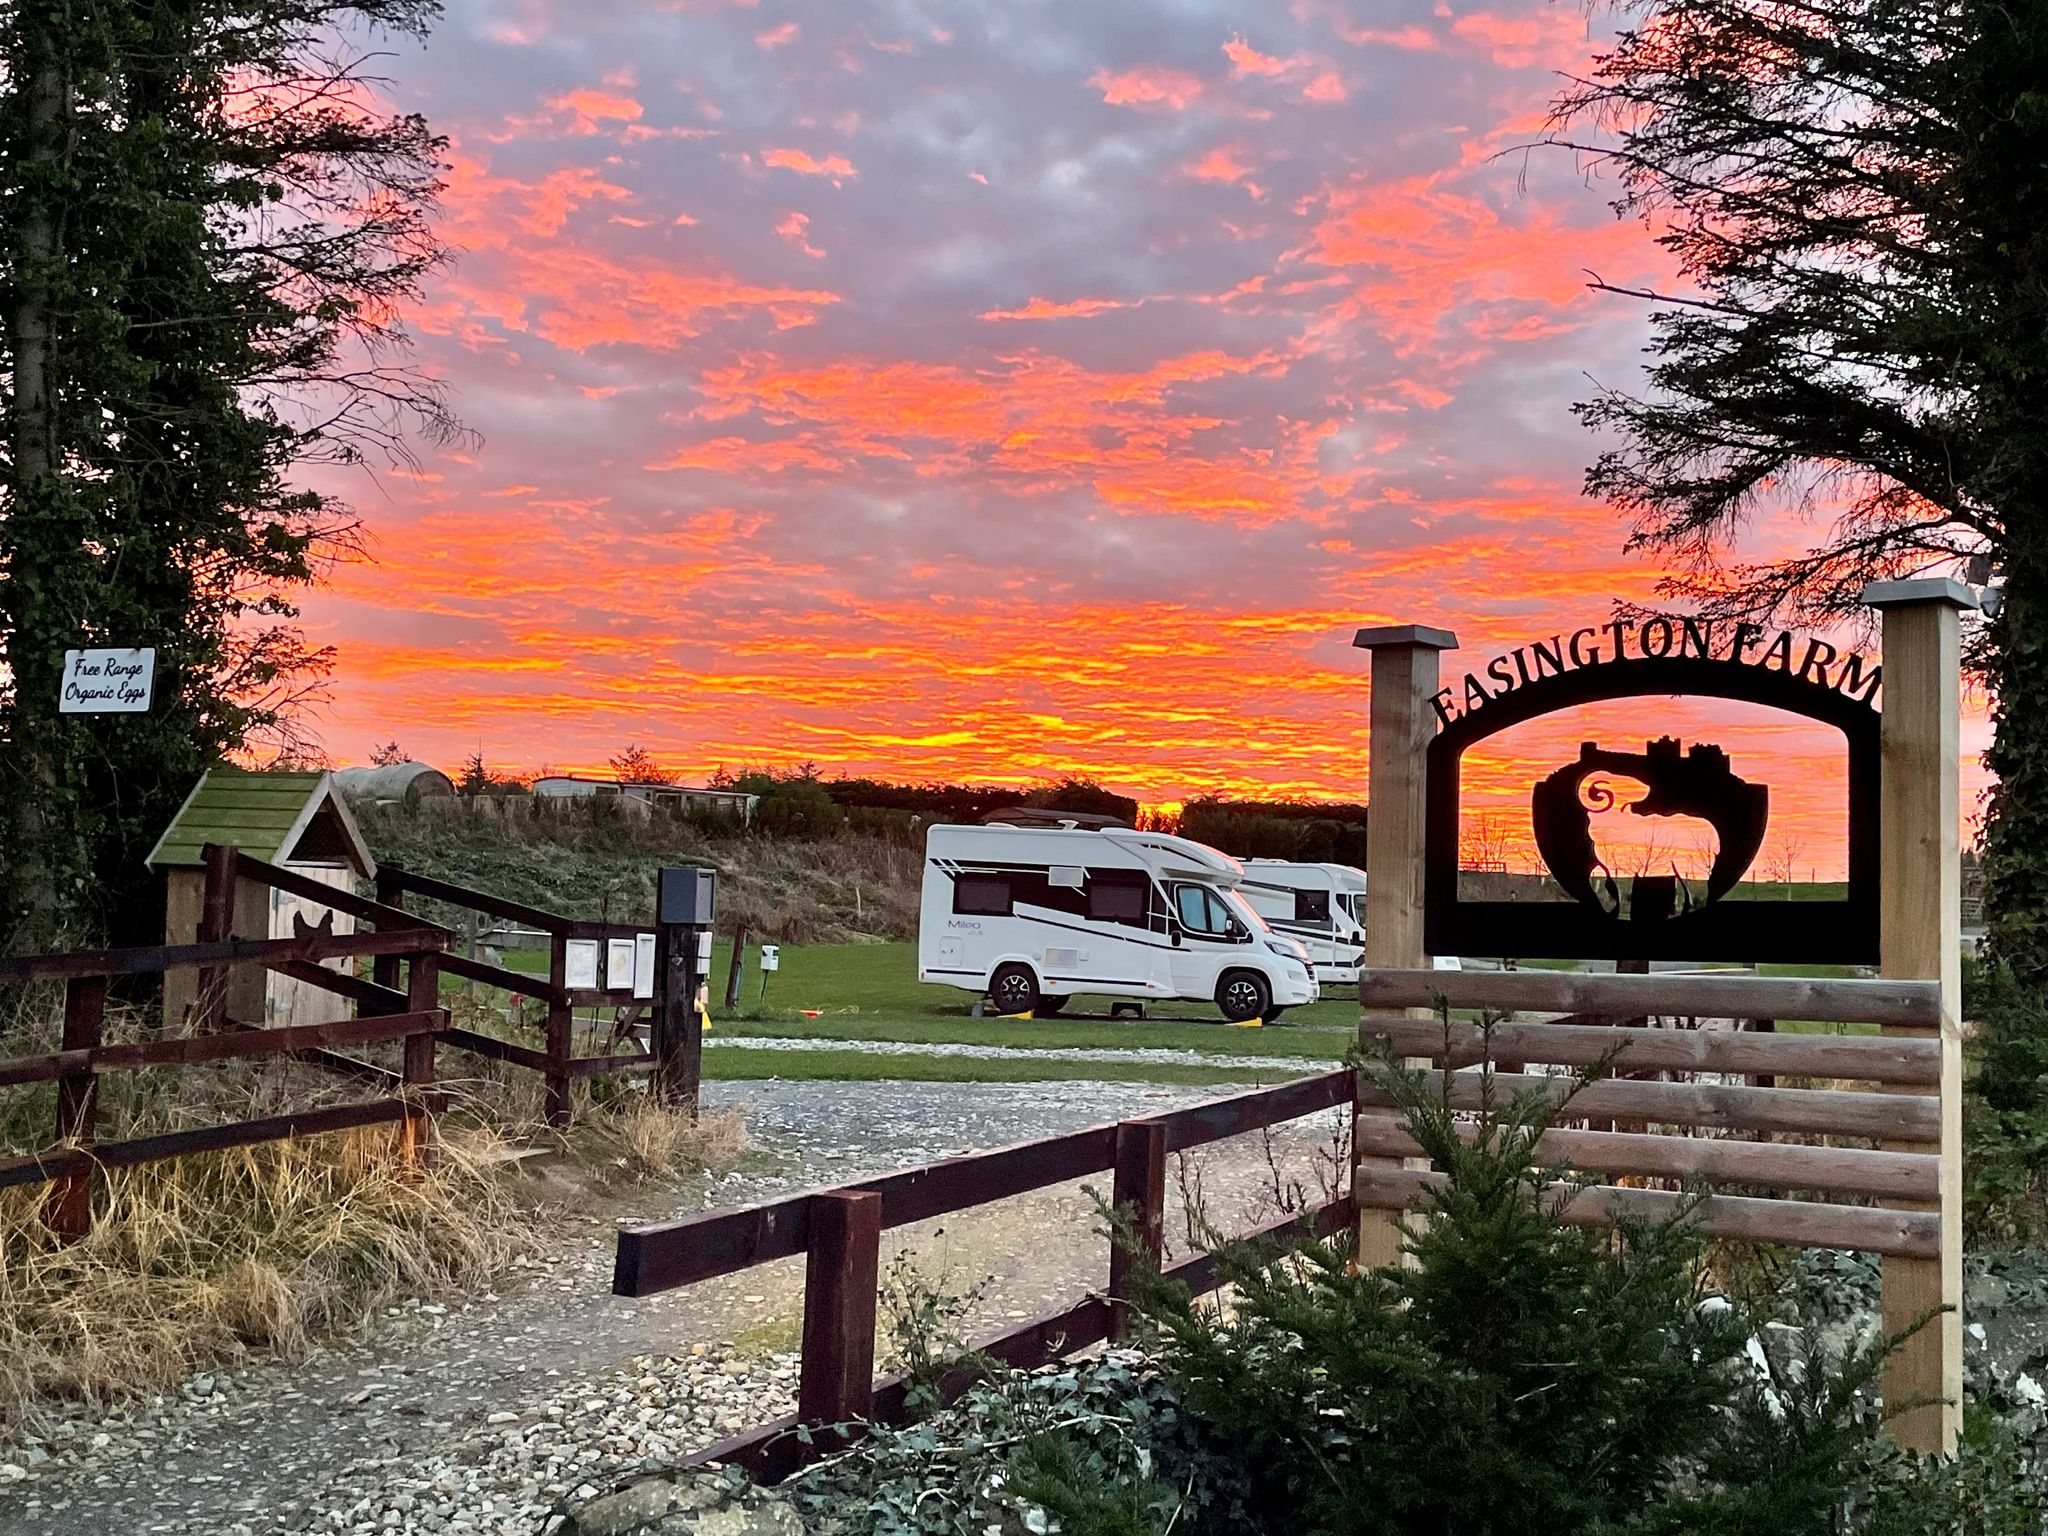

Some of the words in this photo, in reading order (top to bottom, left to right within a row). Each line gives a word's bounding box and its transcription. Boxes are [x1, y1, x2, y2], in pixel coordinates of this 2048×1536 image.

[74, 658, 100, 677] Free
[103, 657, 143, 680] Range
[1428, 617, 1712, 728] EASINGTON
[1729, 622, 1883, 712] FARM
[65, 681, 114, 704] Organic
[117, 680, 146, 704] Eggs
